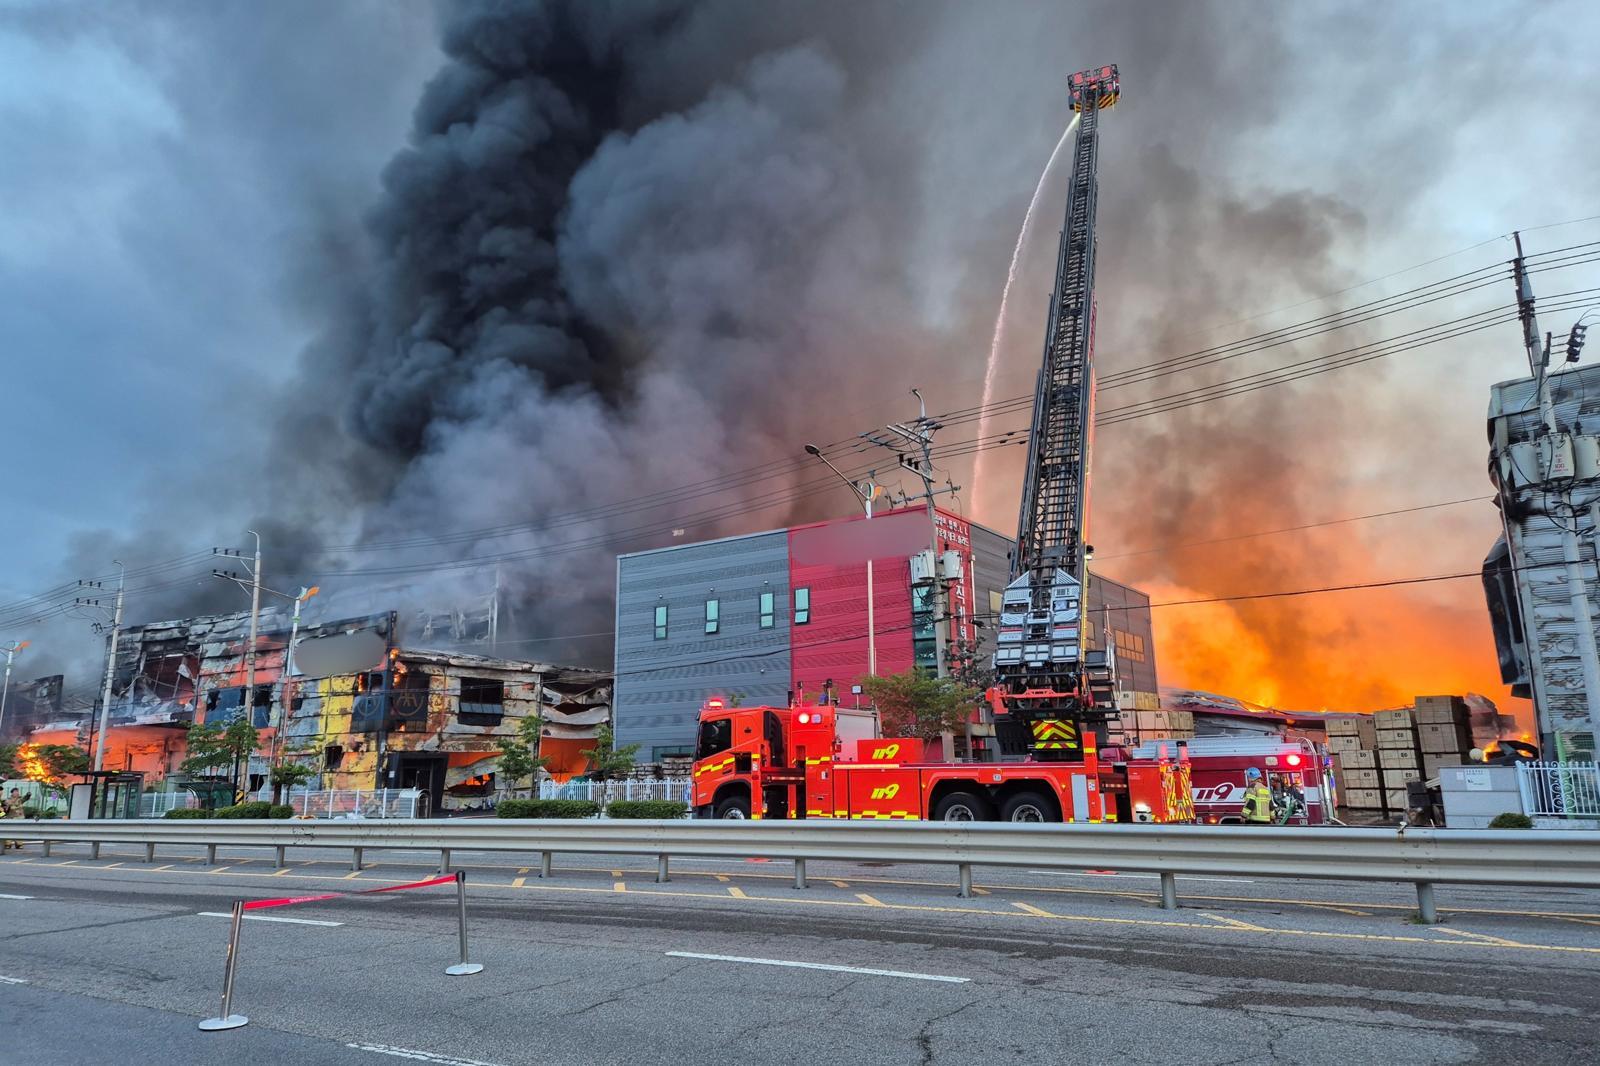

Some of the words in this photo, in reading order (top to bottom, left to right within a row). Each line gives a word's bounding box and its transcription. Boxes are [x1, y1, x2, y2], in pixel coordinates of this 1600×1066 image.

[871, 743, 900, 760] 119
[871, 783, 900, 800] 119
[1196, 783, 1234, 800] 119
